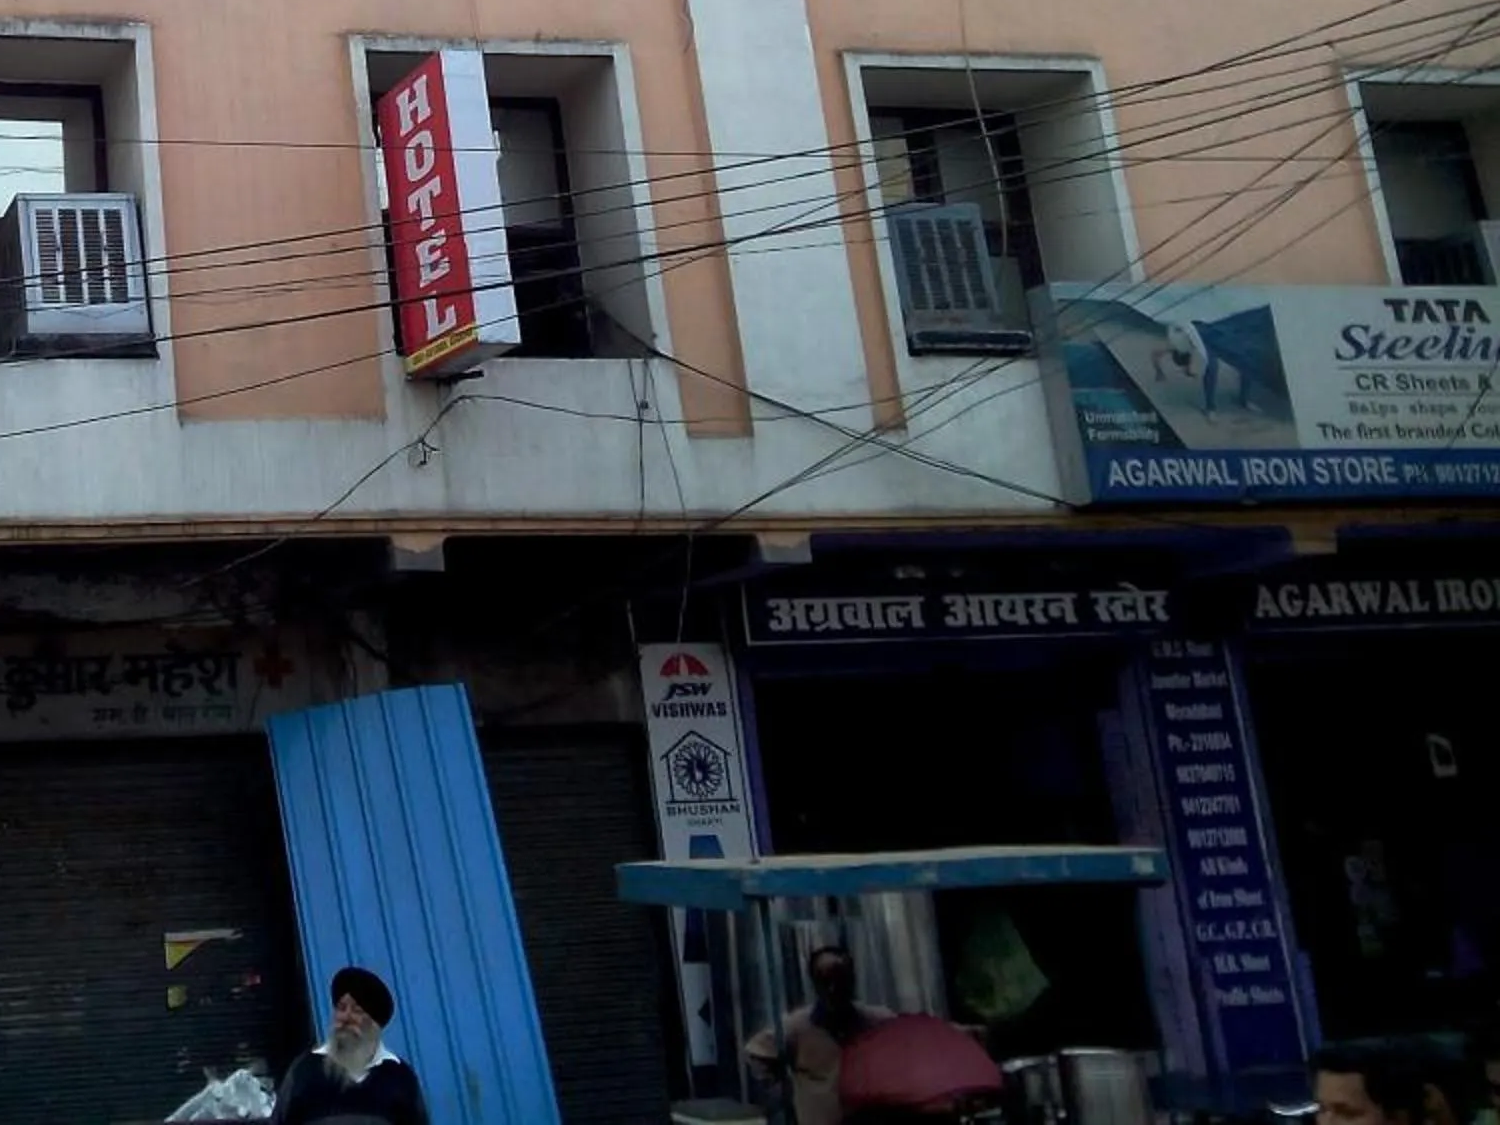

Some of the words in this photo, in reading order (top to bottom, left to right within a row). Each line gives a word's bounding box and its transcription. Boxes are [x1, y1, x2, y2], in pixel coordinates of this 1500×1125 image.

[395, 74, 457, 341] HOTEL
[1384, 298, 1492, 323] TATA
[1355, 373, 1390, 392] CR
[1395, 372, 1471, 392] Sheets
[1316, 422, 1350, 440] The
[1356, 421, 1391, 440] first
[1394, 422, 1466, 439] branded
[1108, 457, 1239, 488] AGARWAL
[1241, 456, 1308, 487] IRON
[1312, 455, 1399, 485] STORE
[764, 594, 927, 634] अग्रवाल
[941, 591, 1080, 629] आयरन
[1087, 581, 1171, 625] स्टोर
[1253, 579, 1432, 619] AGARWAL
[662, 682, 714, 700] JSW
[651, 701, 728, 718] VISHWAS
[665, 802, 741, 818] BHUSHAN
